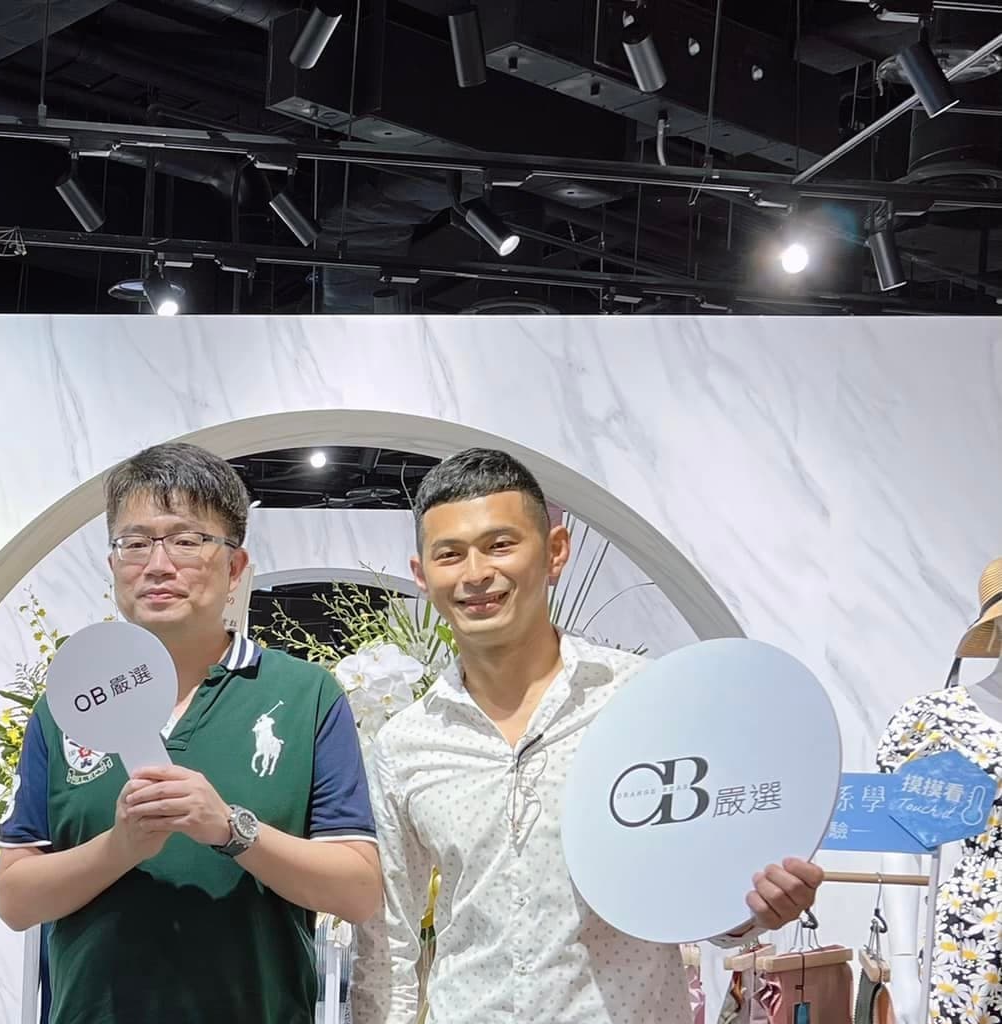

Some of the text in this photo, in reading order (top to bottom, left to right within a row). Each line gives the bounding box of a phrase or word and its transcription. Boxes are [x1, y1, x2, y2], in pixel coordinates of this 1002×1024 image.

[712, 780, 783, 819] 嚴選
[901, 773, 965, 804] 摸摸看
